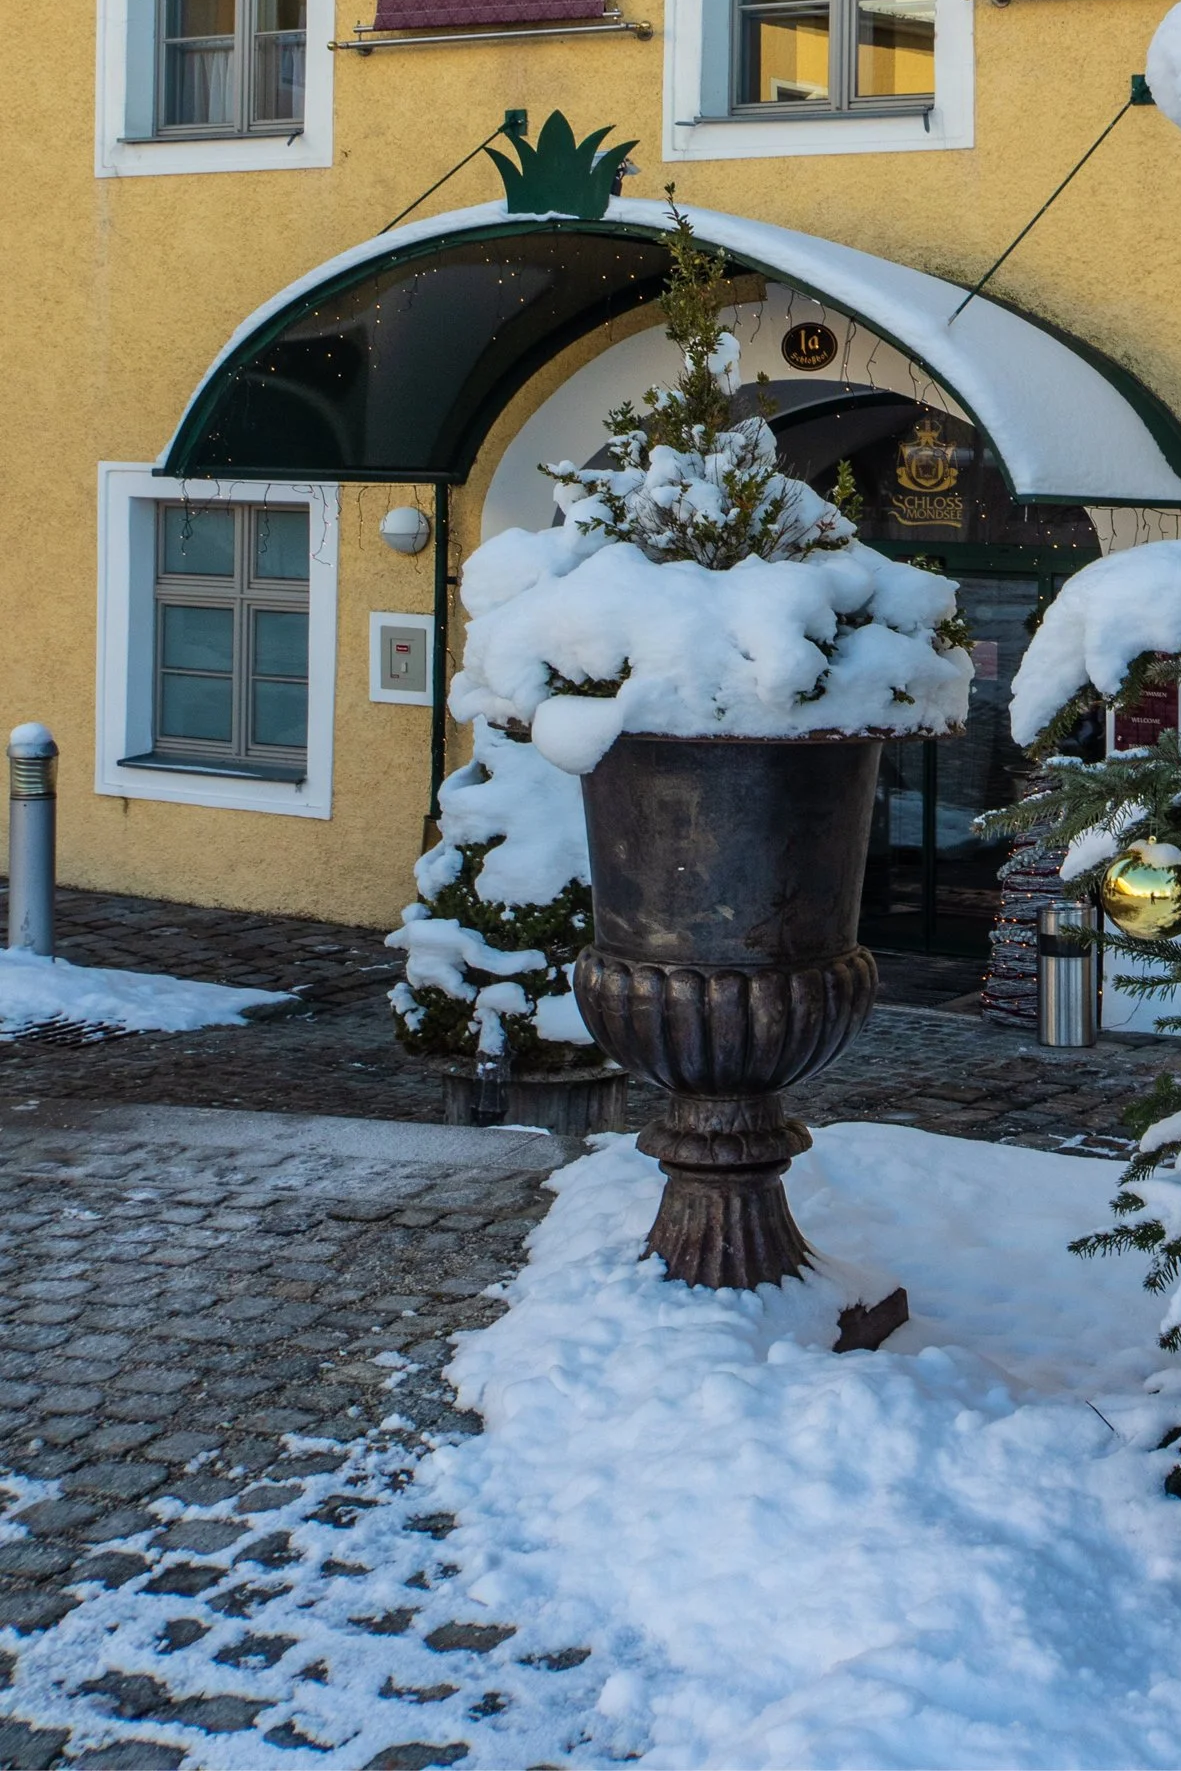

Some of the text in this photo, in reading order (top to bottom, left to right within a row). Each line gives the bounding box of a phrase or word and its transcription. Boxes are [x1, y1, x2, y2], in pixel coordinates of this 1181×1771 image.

[891, 494, 964, 514] SCHLOSS
[905, 509, 963, 520] MONDSEE
[1130, 716, 1161, 724] WELCOME
